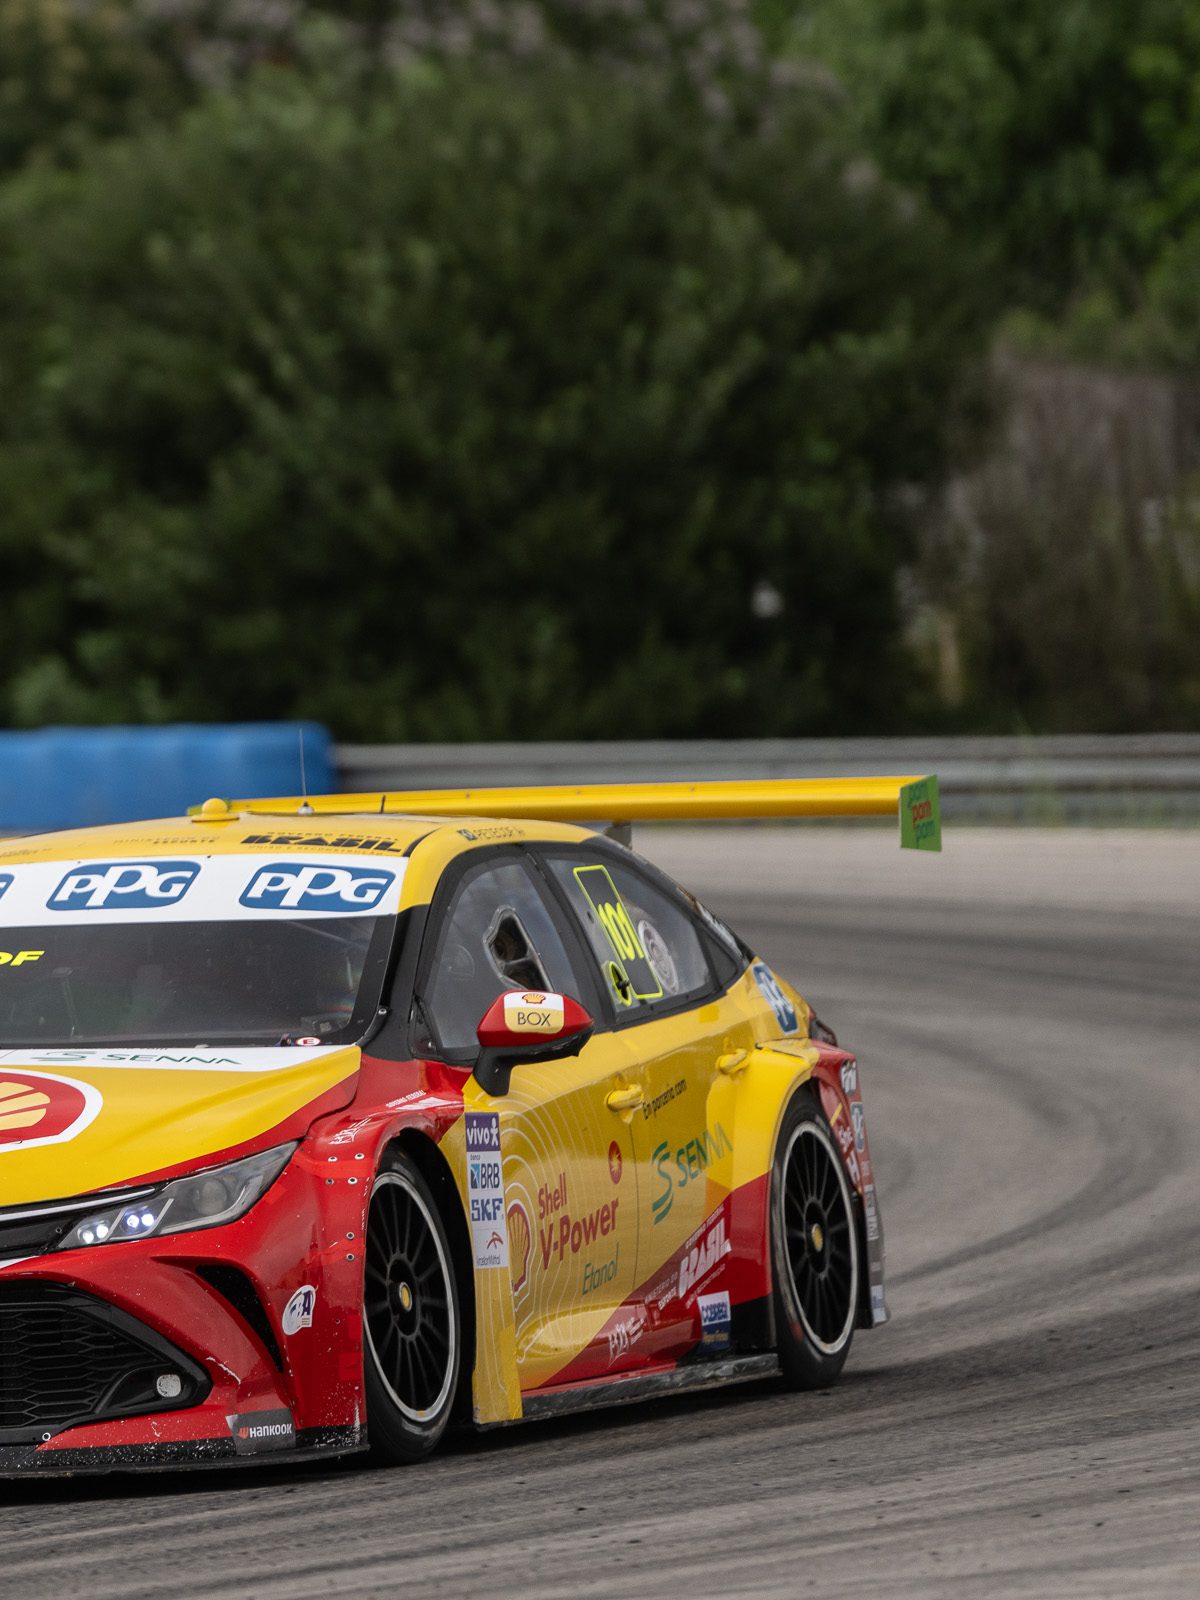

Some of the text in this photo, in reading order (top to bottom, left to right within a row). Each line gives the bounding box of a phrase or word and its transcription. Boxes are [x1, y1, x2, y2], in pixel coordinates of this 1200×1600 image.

[240, 835, 402, 853] BRASIL
[54, 865, 194, 907] PPG
[247, 867, 389, 907] PPG
[597, 902, 644, 961] 101
[517, 1011, 551, 1026] BOX
[102, 1053, 242, 1065] SENNA
[466, 1120, 490, 1145] vivo
[676, 1121, 734, 1188] SENNA
[480, 1163, 500, 1189] BRB
[538, 1171, 567, 1220] Shell
[471, 1198, 503, 1222] SKF
[540, 1198, 619, 1271] V-Power
[582, 1241, 620, 1296] Etanol
[678, 1217, 732, 1299] BRASIL
